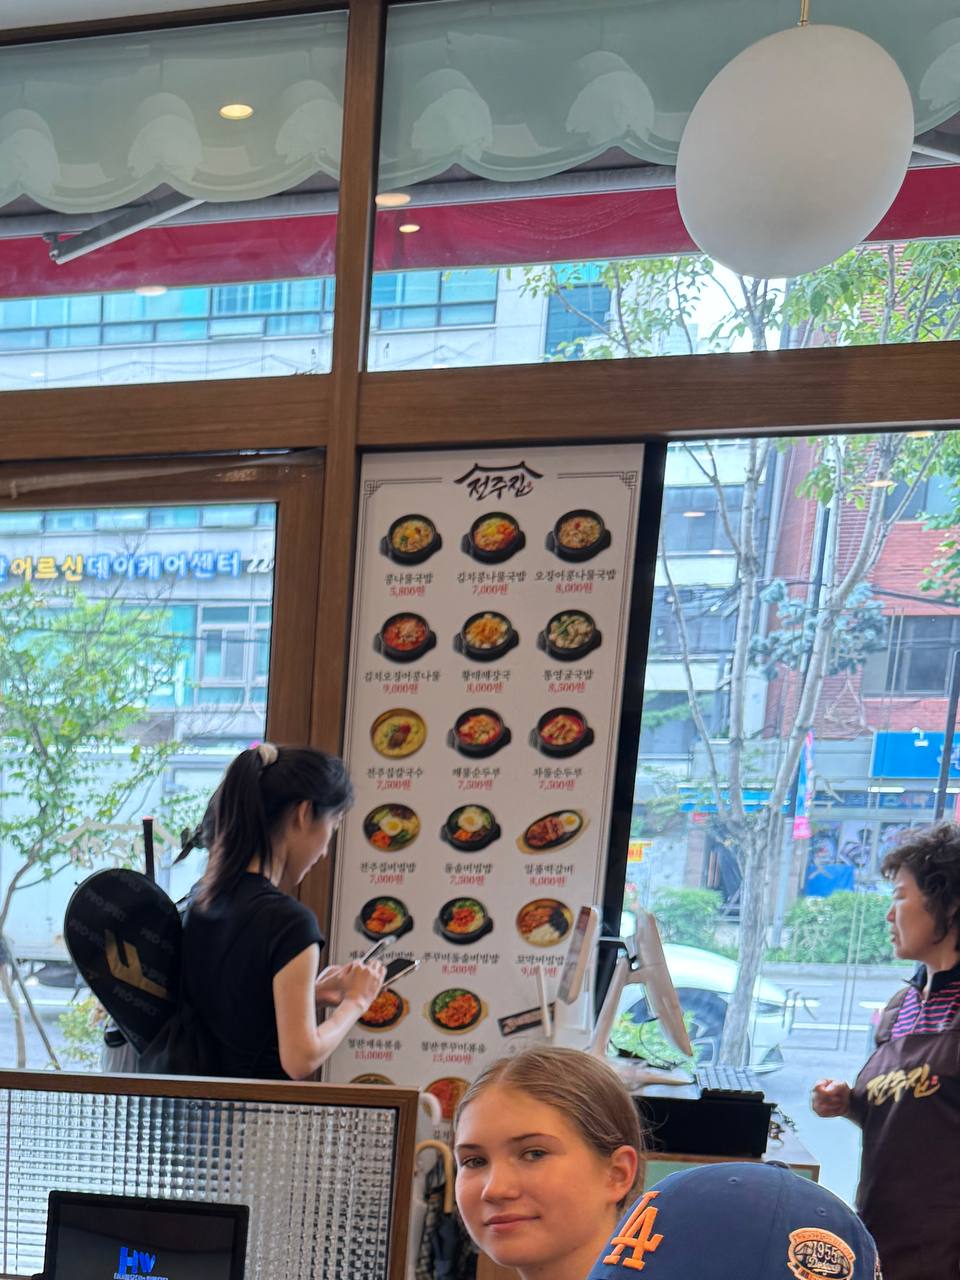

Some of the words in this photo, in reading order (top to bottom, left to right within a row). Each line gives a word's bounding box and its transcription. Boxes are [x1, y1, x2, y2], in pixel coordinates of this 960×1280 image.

[467, 474, 534, 501] 전주집
[385, 572, 433, 585] 콩나물국밥
[865, 1063, 940, 1106] 전주집
[603, 1190, 664, 1271] LA
[812, 1241, 838, 1264] 1955
